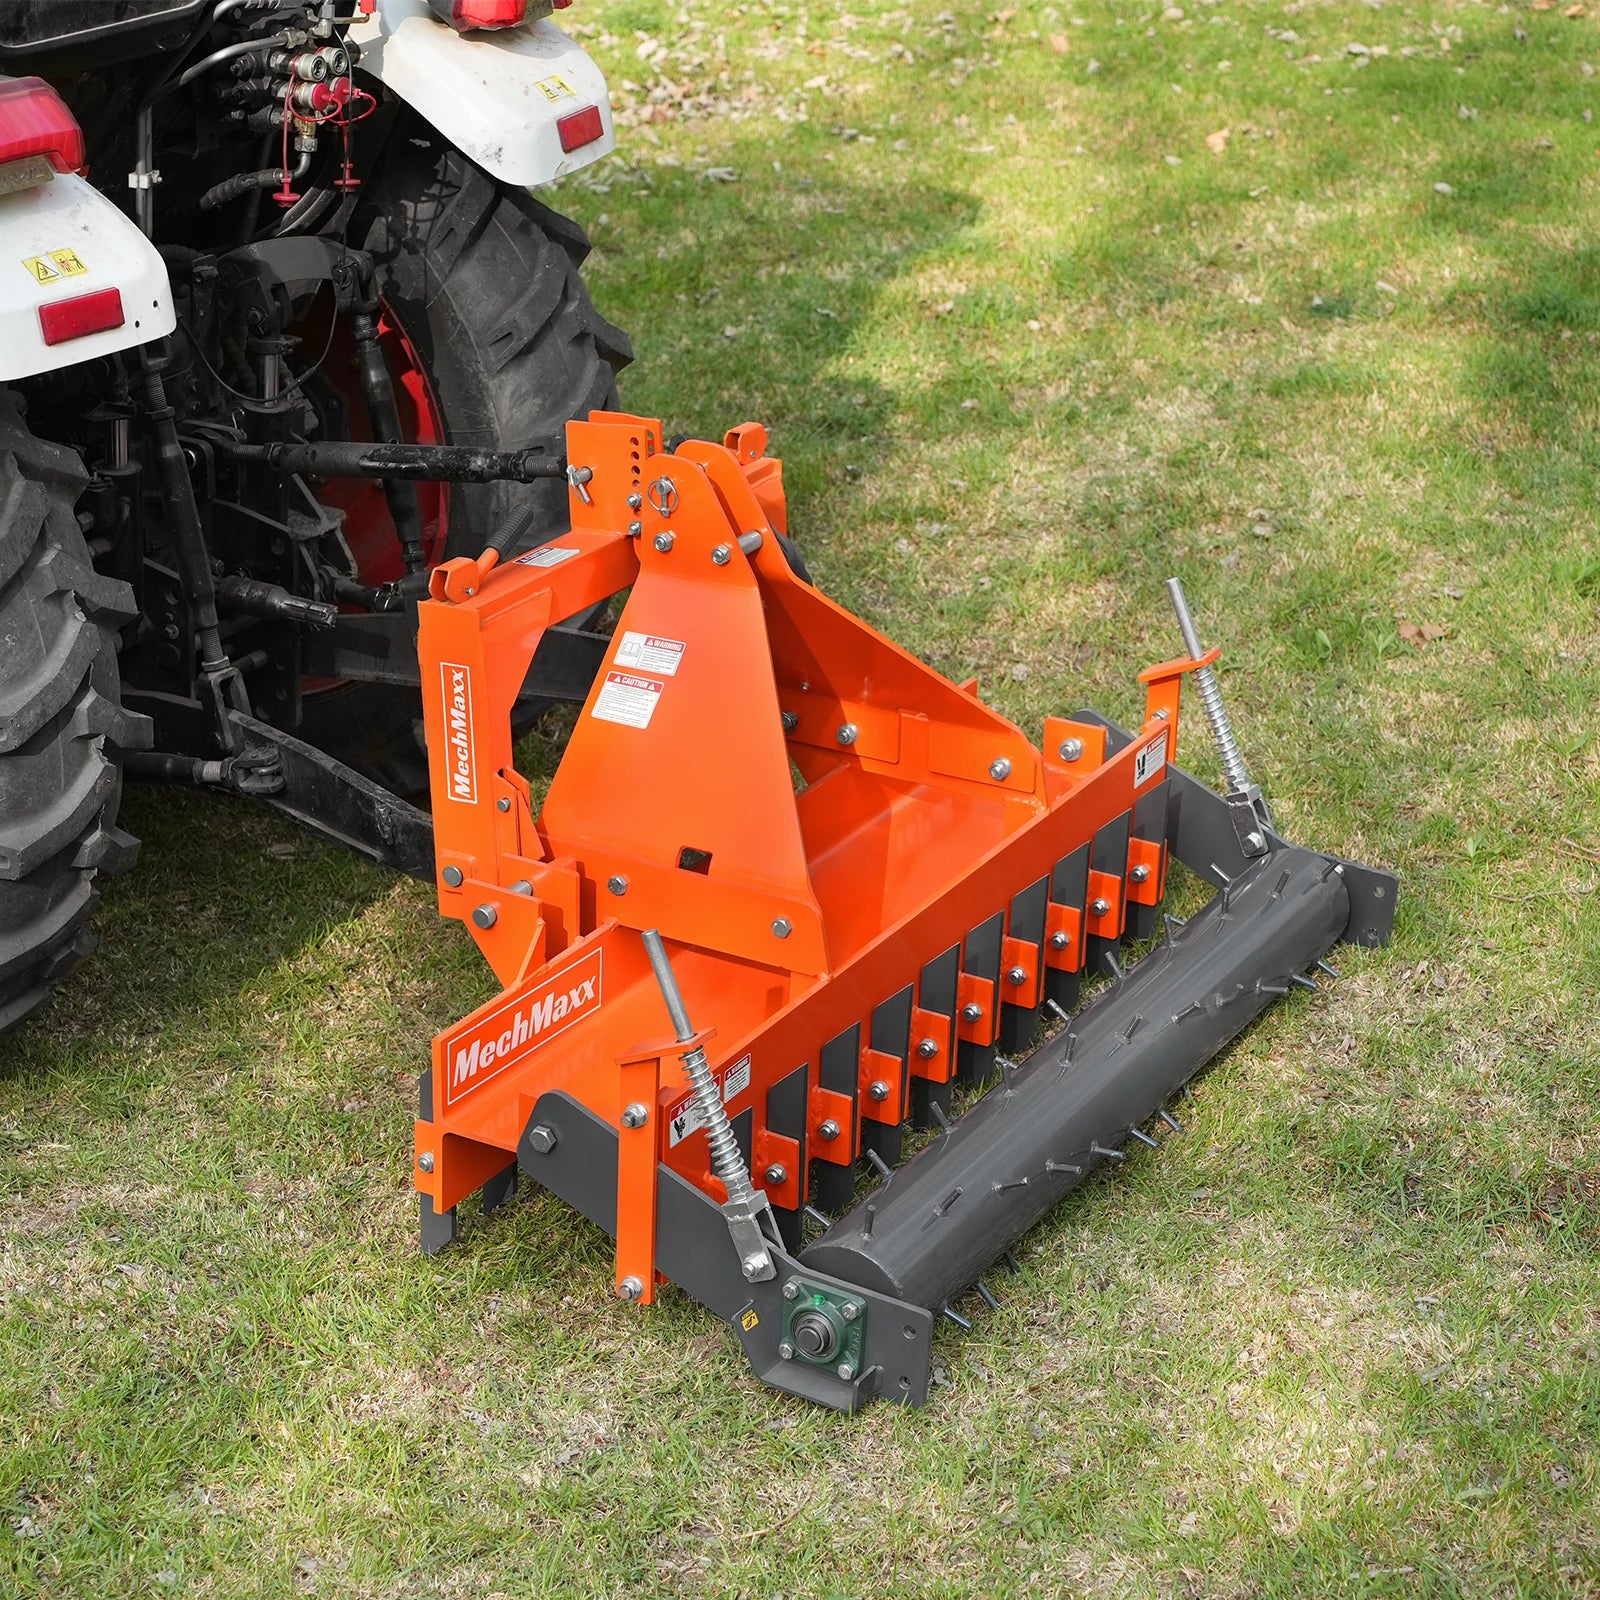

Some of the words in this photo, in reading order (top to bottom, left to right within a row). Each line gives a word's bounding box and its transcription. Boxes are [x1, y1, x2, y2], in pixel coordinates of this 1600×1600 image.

[653, 639, 683, 652] WARNING
[621, 676, 649, 689] CAUTION
[450, 668, 471, 799] MechMaxx
[453, 974, 597, 1088] MechMaxx
